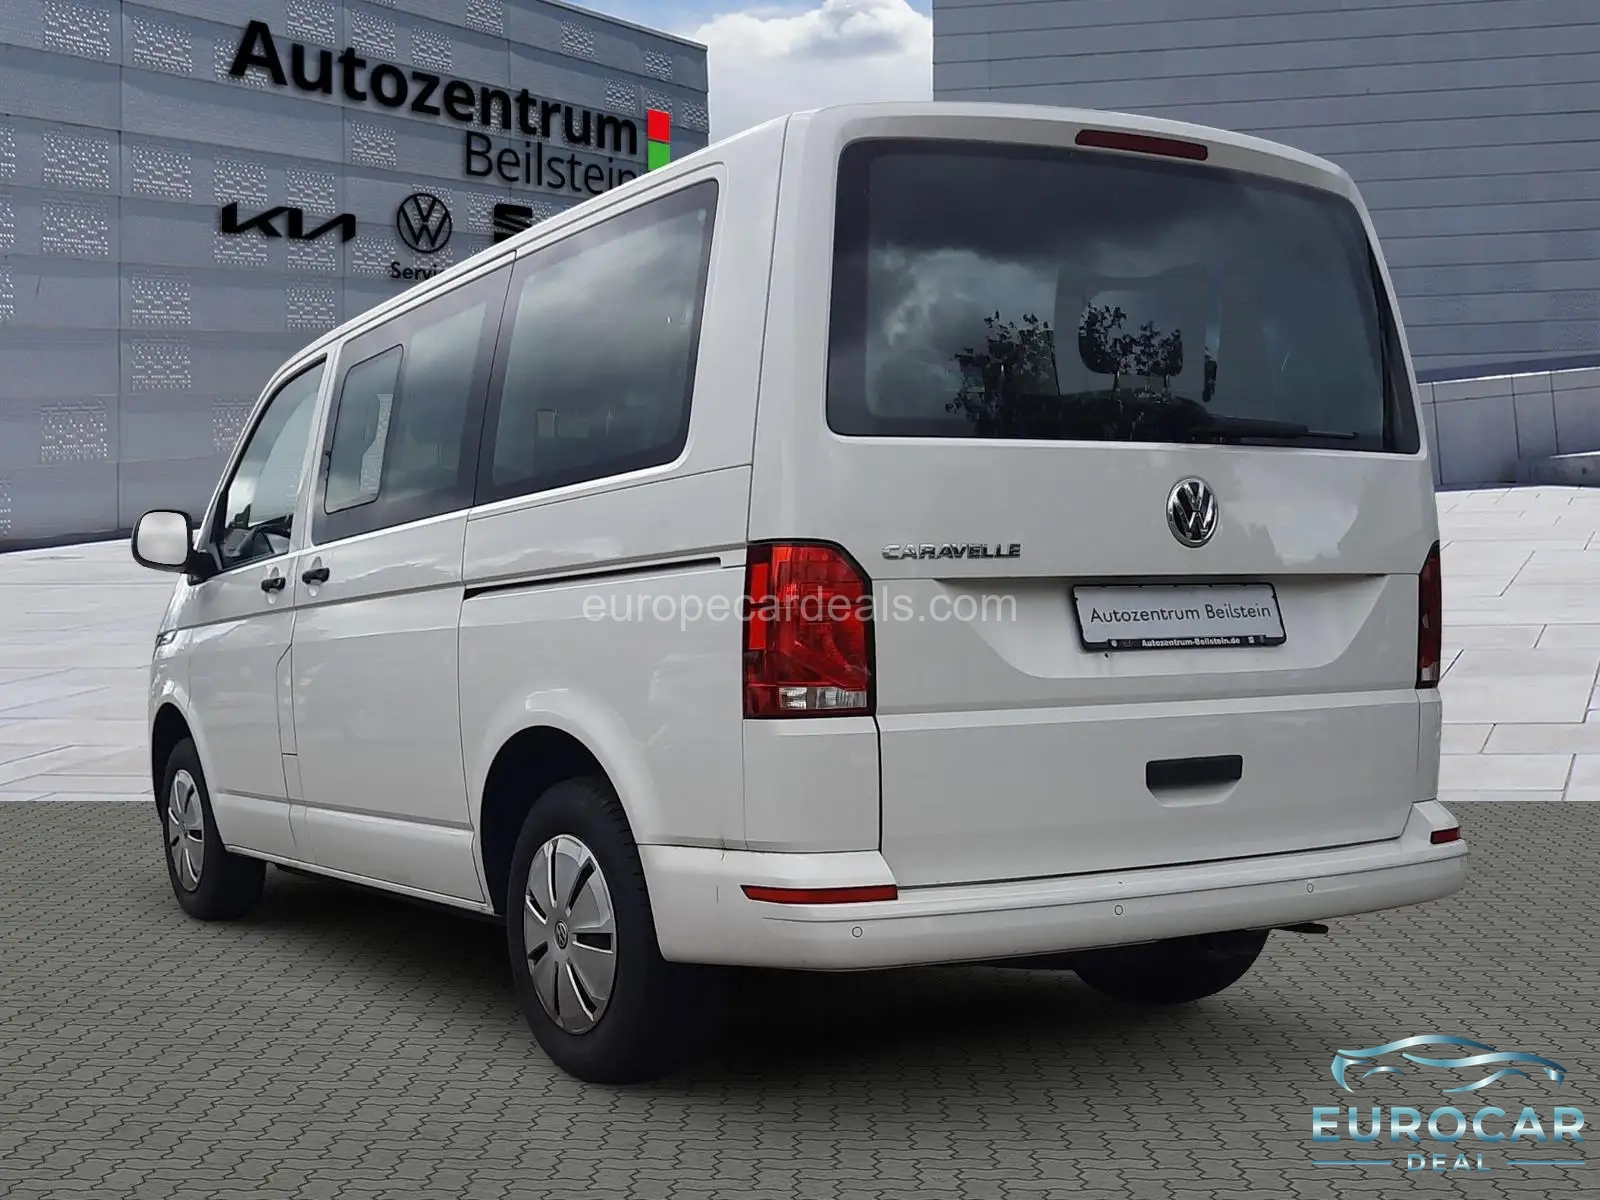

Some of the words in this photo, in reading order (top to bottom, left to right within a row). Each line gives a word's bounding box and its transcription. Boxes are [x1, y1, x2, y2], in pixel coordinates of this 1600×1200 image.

[229, 19, 638, 156] Autozentrum
[390, 261, 445, 280] Servi
[882, 543, 1021, 560] CARAVELLE
[1090, 607, 1201, 624] Autozentrum
[1204, 602, 1272, 620] Beilstein
